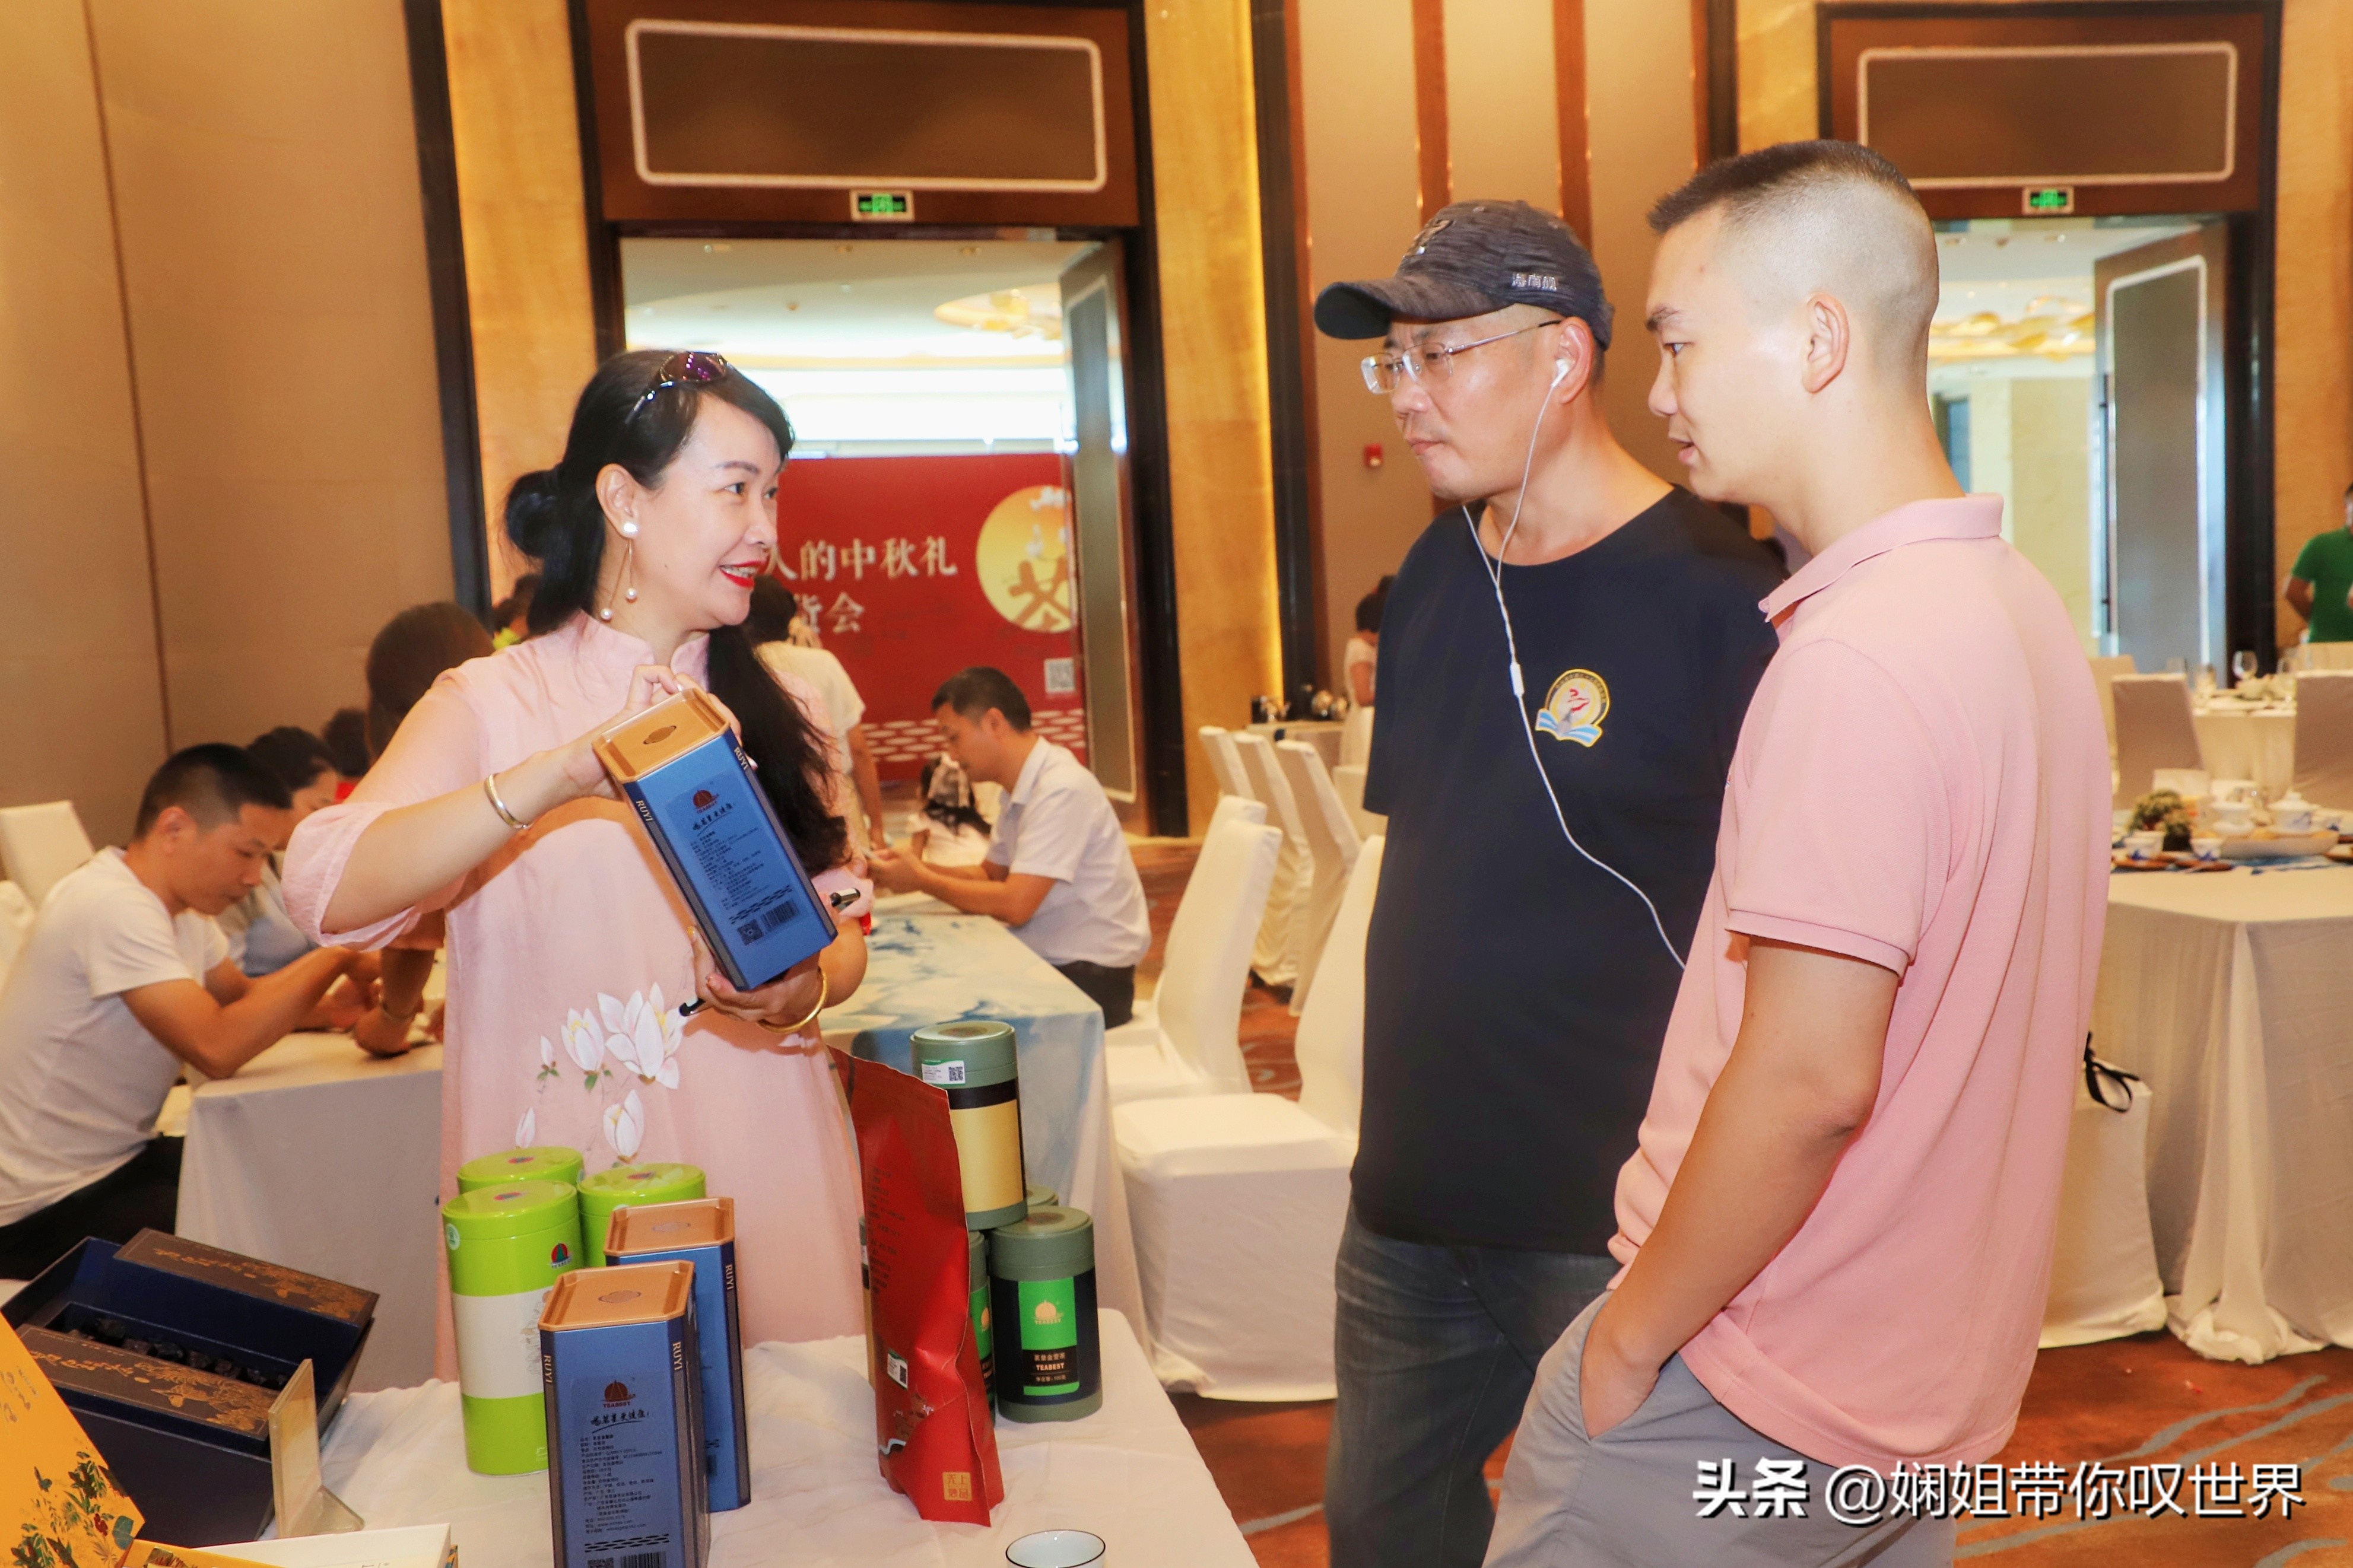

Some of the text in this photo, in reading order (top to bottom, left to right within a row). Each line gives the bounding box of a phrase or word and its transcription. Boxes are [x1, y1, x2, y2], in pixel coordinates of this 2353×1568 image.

[734, 747, 748, 770] RUYI
[636, 800, 653, 821] RUYI
[725, 1264, 734, 1290] RUYI
[672, 1341, 682, 1370] RUYI
[1036, 1363, 1065, 1371] TEABEST
[544, 1355, 552, 1383] RUYI
